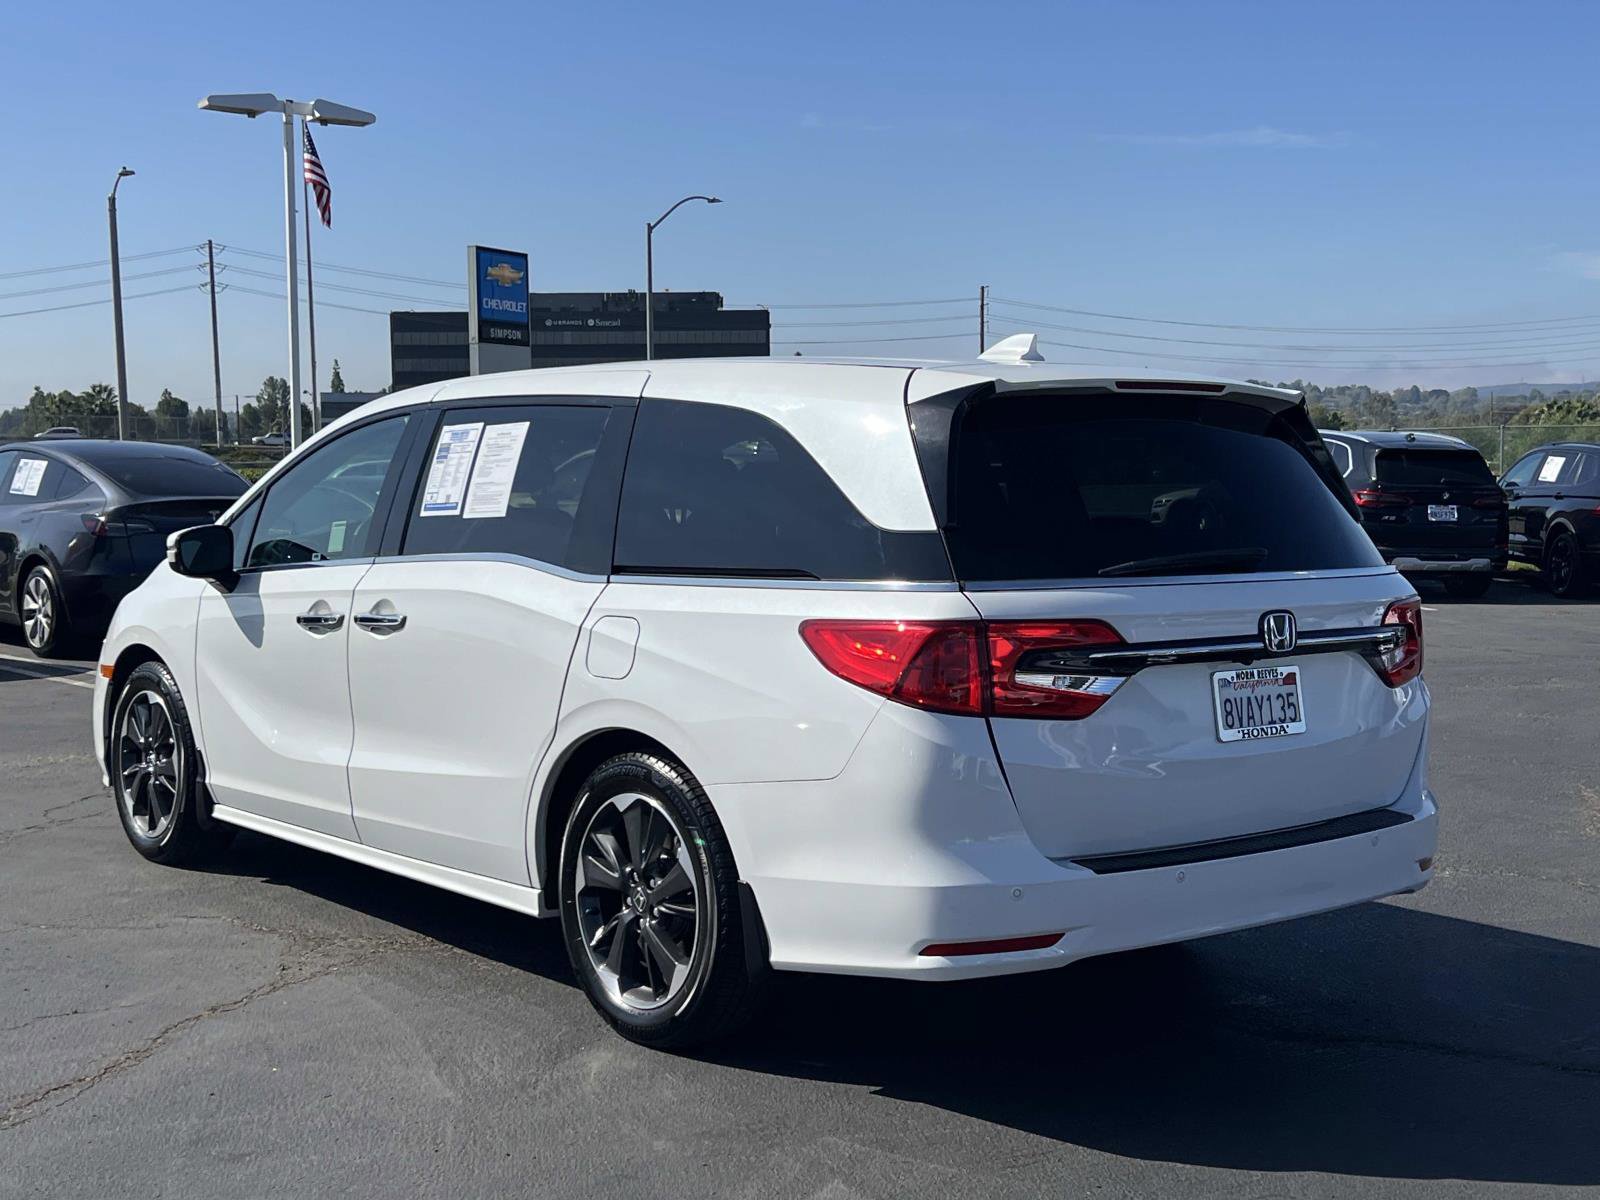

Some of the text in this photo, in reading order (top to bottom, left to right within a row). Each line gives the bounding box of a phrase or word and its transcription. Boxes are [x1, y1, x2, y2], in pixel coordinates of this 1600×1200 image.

[482, 297, 527, 313] CHEVROLET
[490, 328, 521, 340] SIMPSON
[1235, 668, 1279, 681] NORM REEVES
[1223, 692, 1297, 730] 8VAY135
[1241, 725, 1288, 739] HONDA
